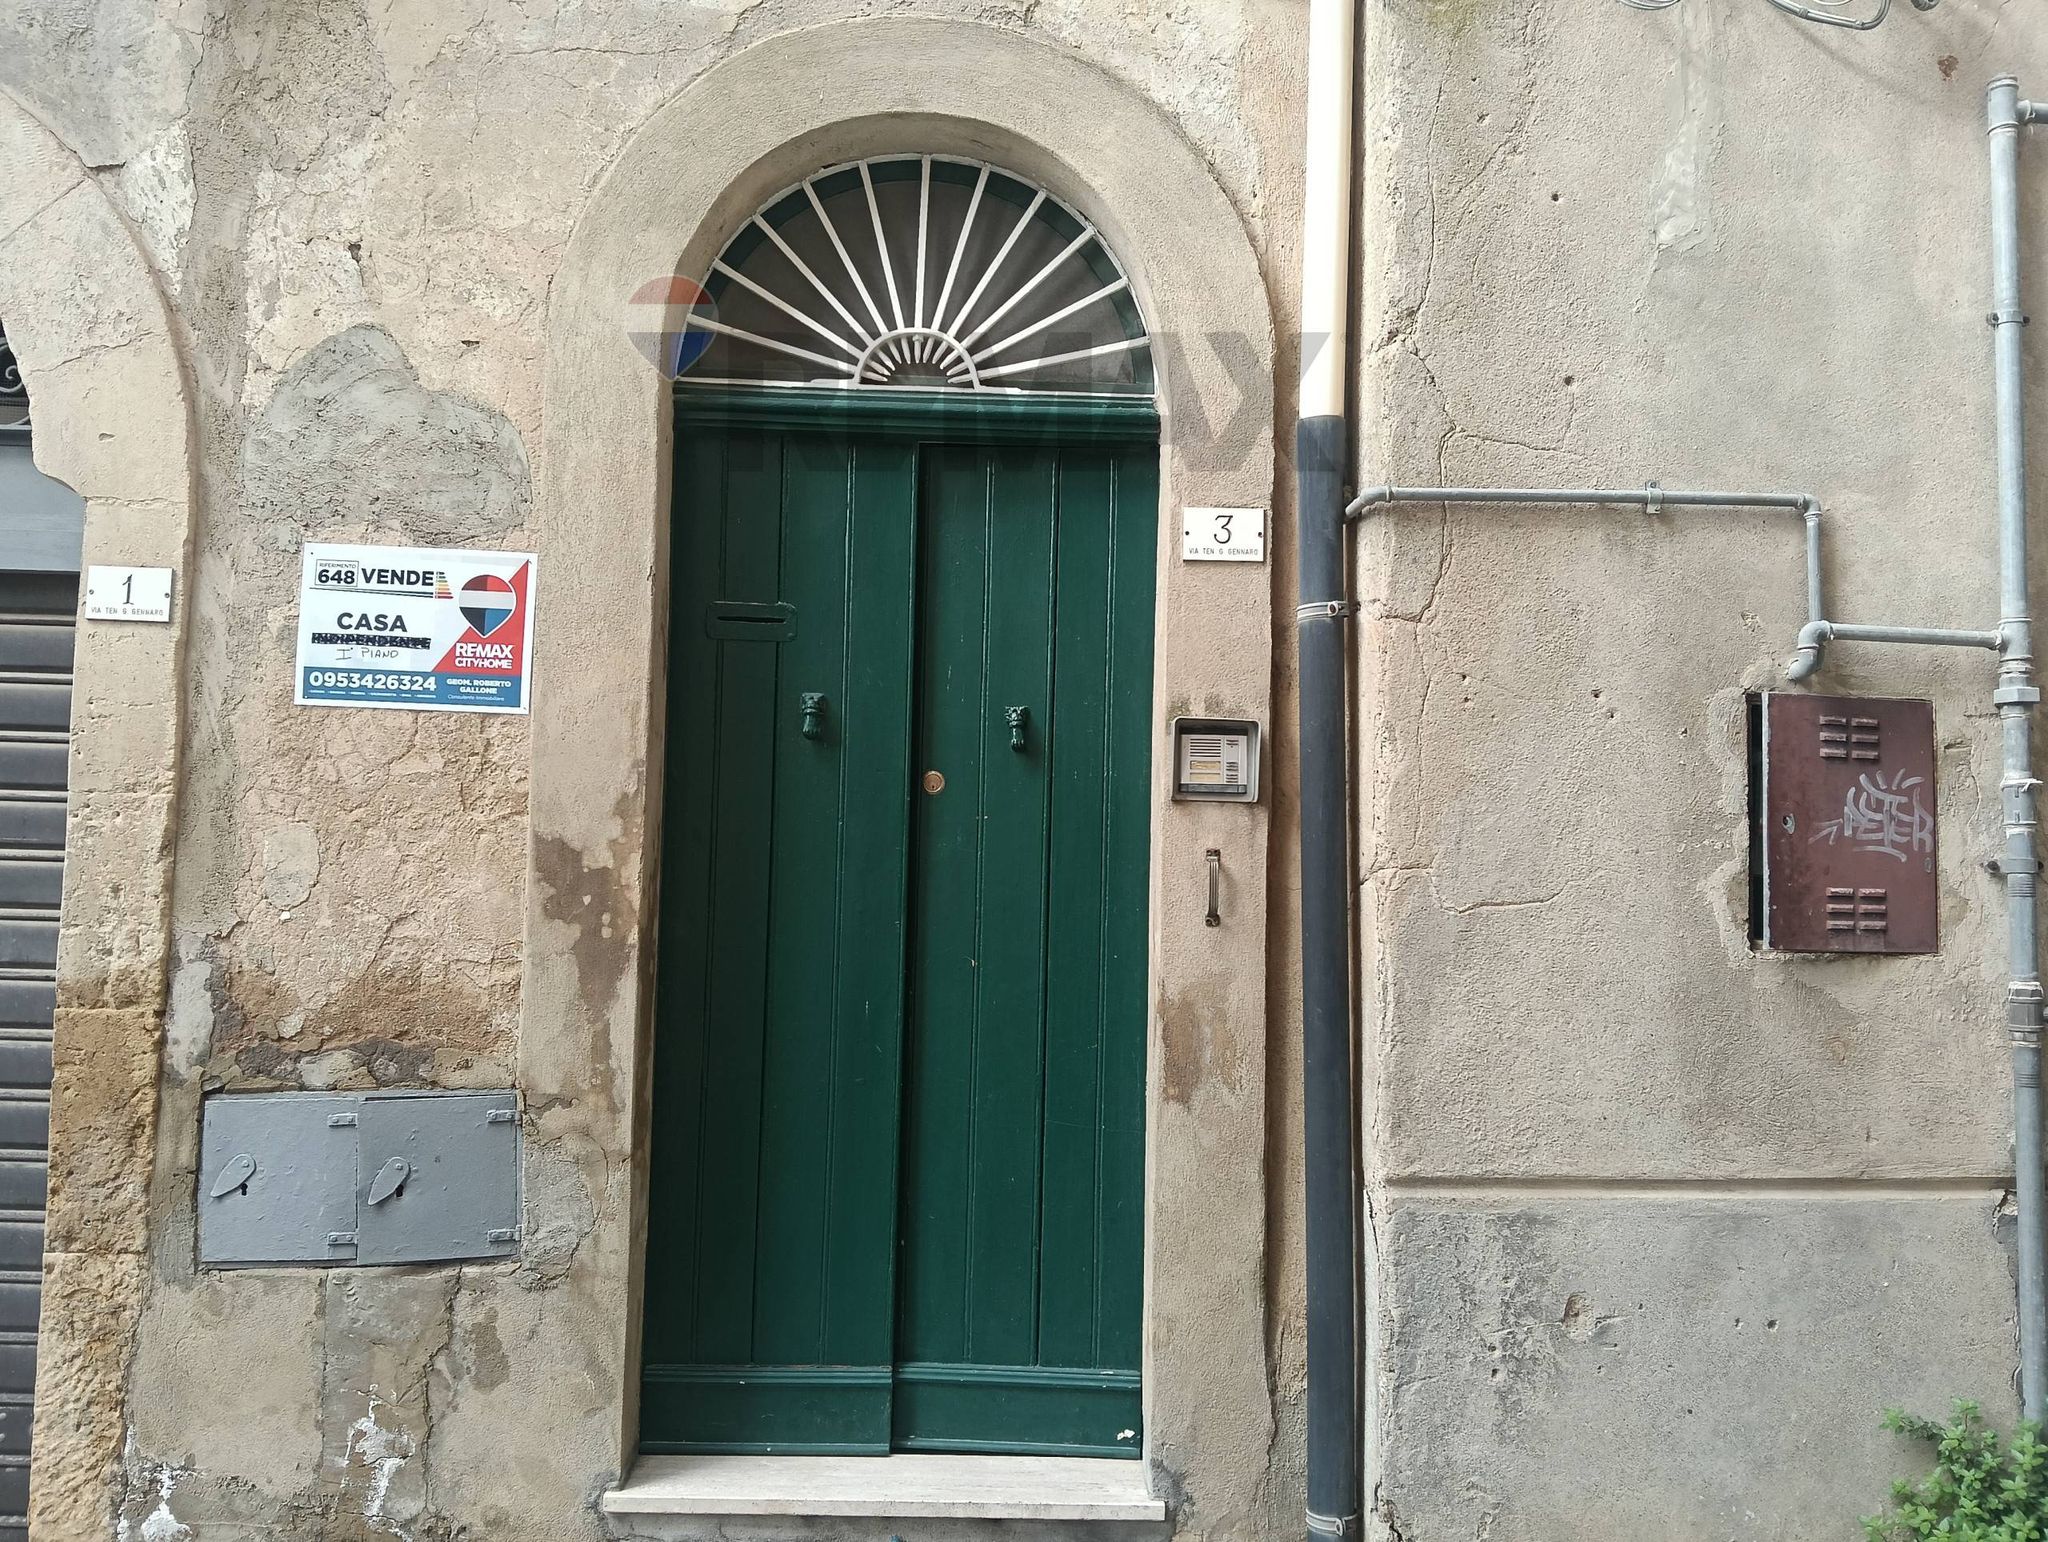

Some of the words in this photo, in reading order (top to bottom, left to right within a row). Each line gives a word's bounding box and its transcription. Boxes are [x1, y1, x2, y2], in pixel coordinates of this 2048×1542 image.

[1213, 514, 1234, 544] 3
[1189, 547, 1199, 555] VIA
[1203, 547, 1215, 555] TEN
[1228, 548, 1259, 556] GENNARO
[317, 568, 356, 585] 648
[361, 567, 435, 587] VENDE
[122, 574, 135, 605] 1
[105, 607, 118, 615] TEN
[336, 612, 408, 633] CASA
[361, 647, 399, 659] PIANO
[455, 642, 515, 659] REMAX
[454, 657, 513, 669] CITYHOME
[309, 671, 437, 692] 0953426324
[446, 678, 472, 687] GEOM.
[473, 679, 512, 688] ROBERTO
[459, 686, 498, 695] GALLONE
